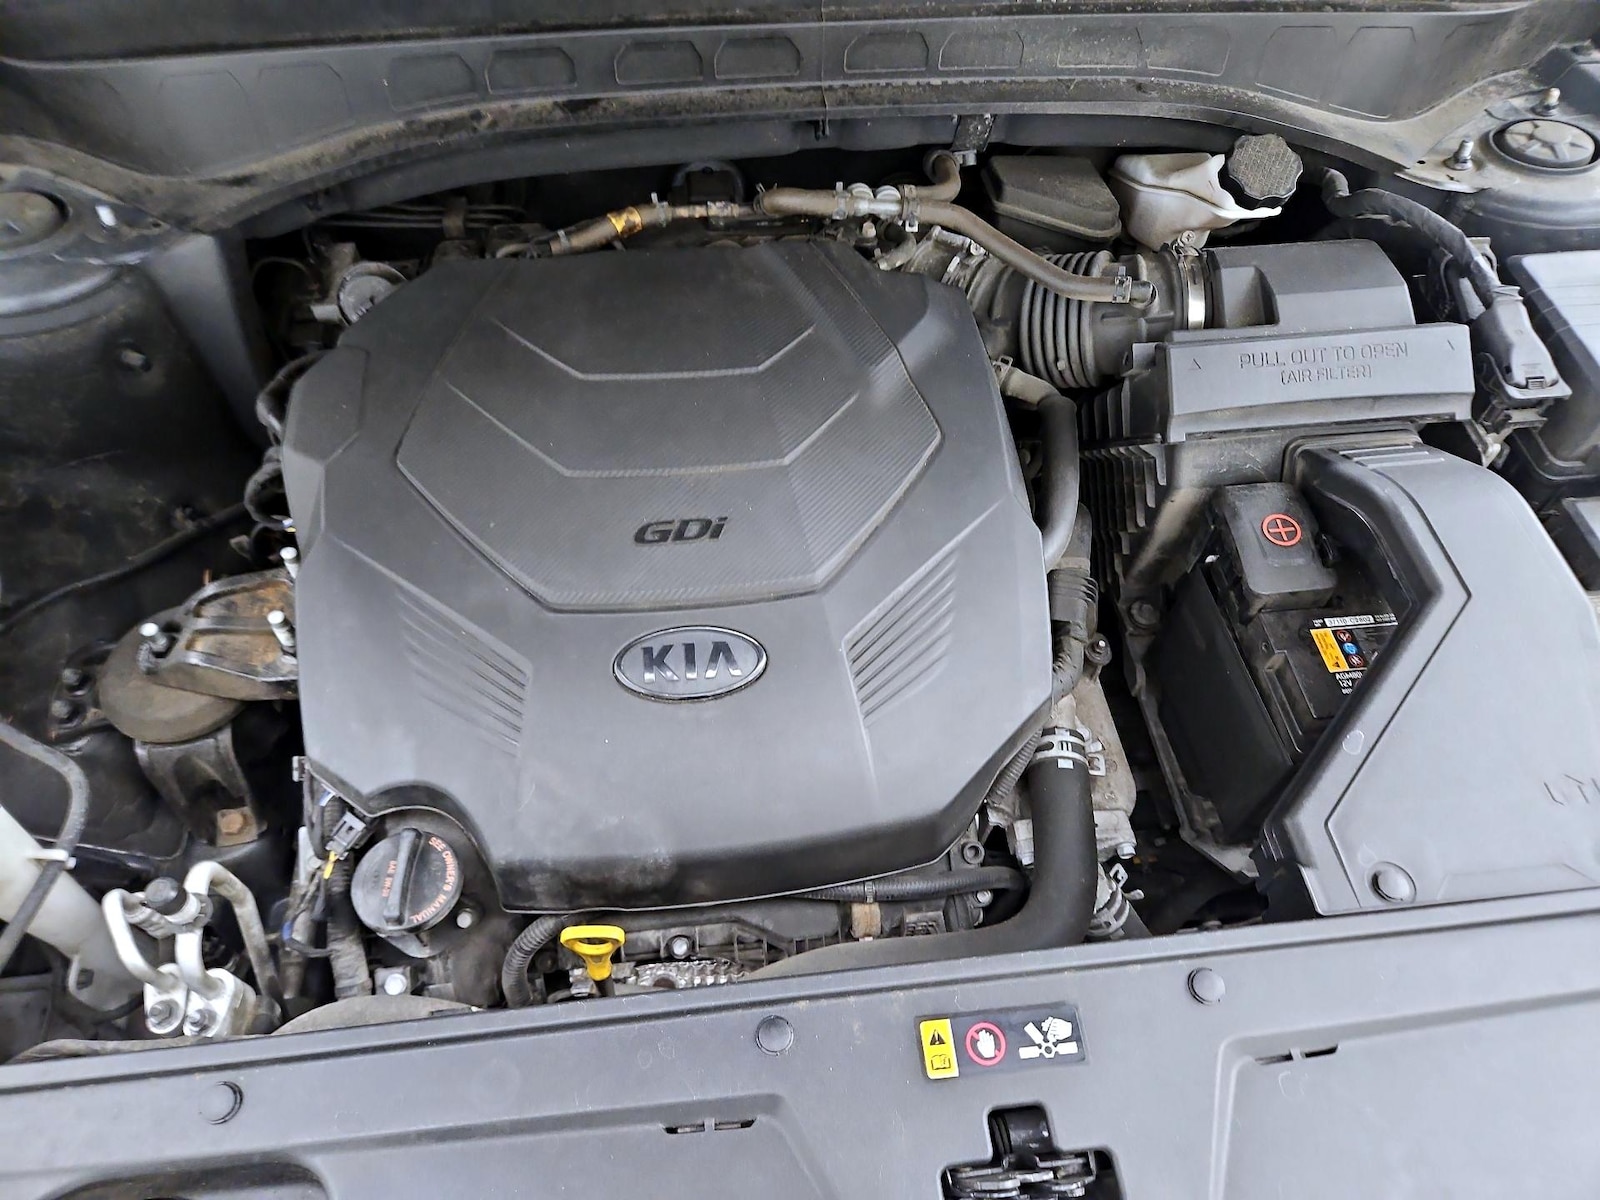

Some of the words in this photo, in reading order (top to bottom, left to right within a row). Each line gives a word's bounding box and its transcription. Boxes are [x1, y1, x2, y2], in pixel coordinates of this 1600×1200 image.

[1239, 351, 1286, 369] PULL
[1291, 347, 1327, 364] OUT
[1331, 345, 1355, 361] TO
[1360, 341, 1408, 360] OPEN
[1280, 368, 1312, 385] (AIR
[634, 516, 728, 545] GDi
[640, 640, 743, 684] KIA
[428, 836, 446, 852] SEE
[442, 850, 455, 891] OWNER'S
[410, 893, 447, 923] MANUAL
